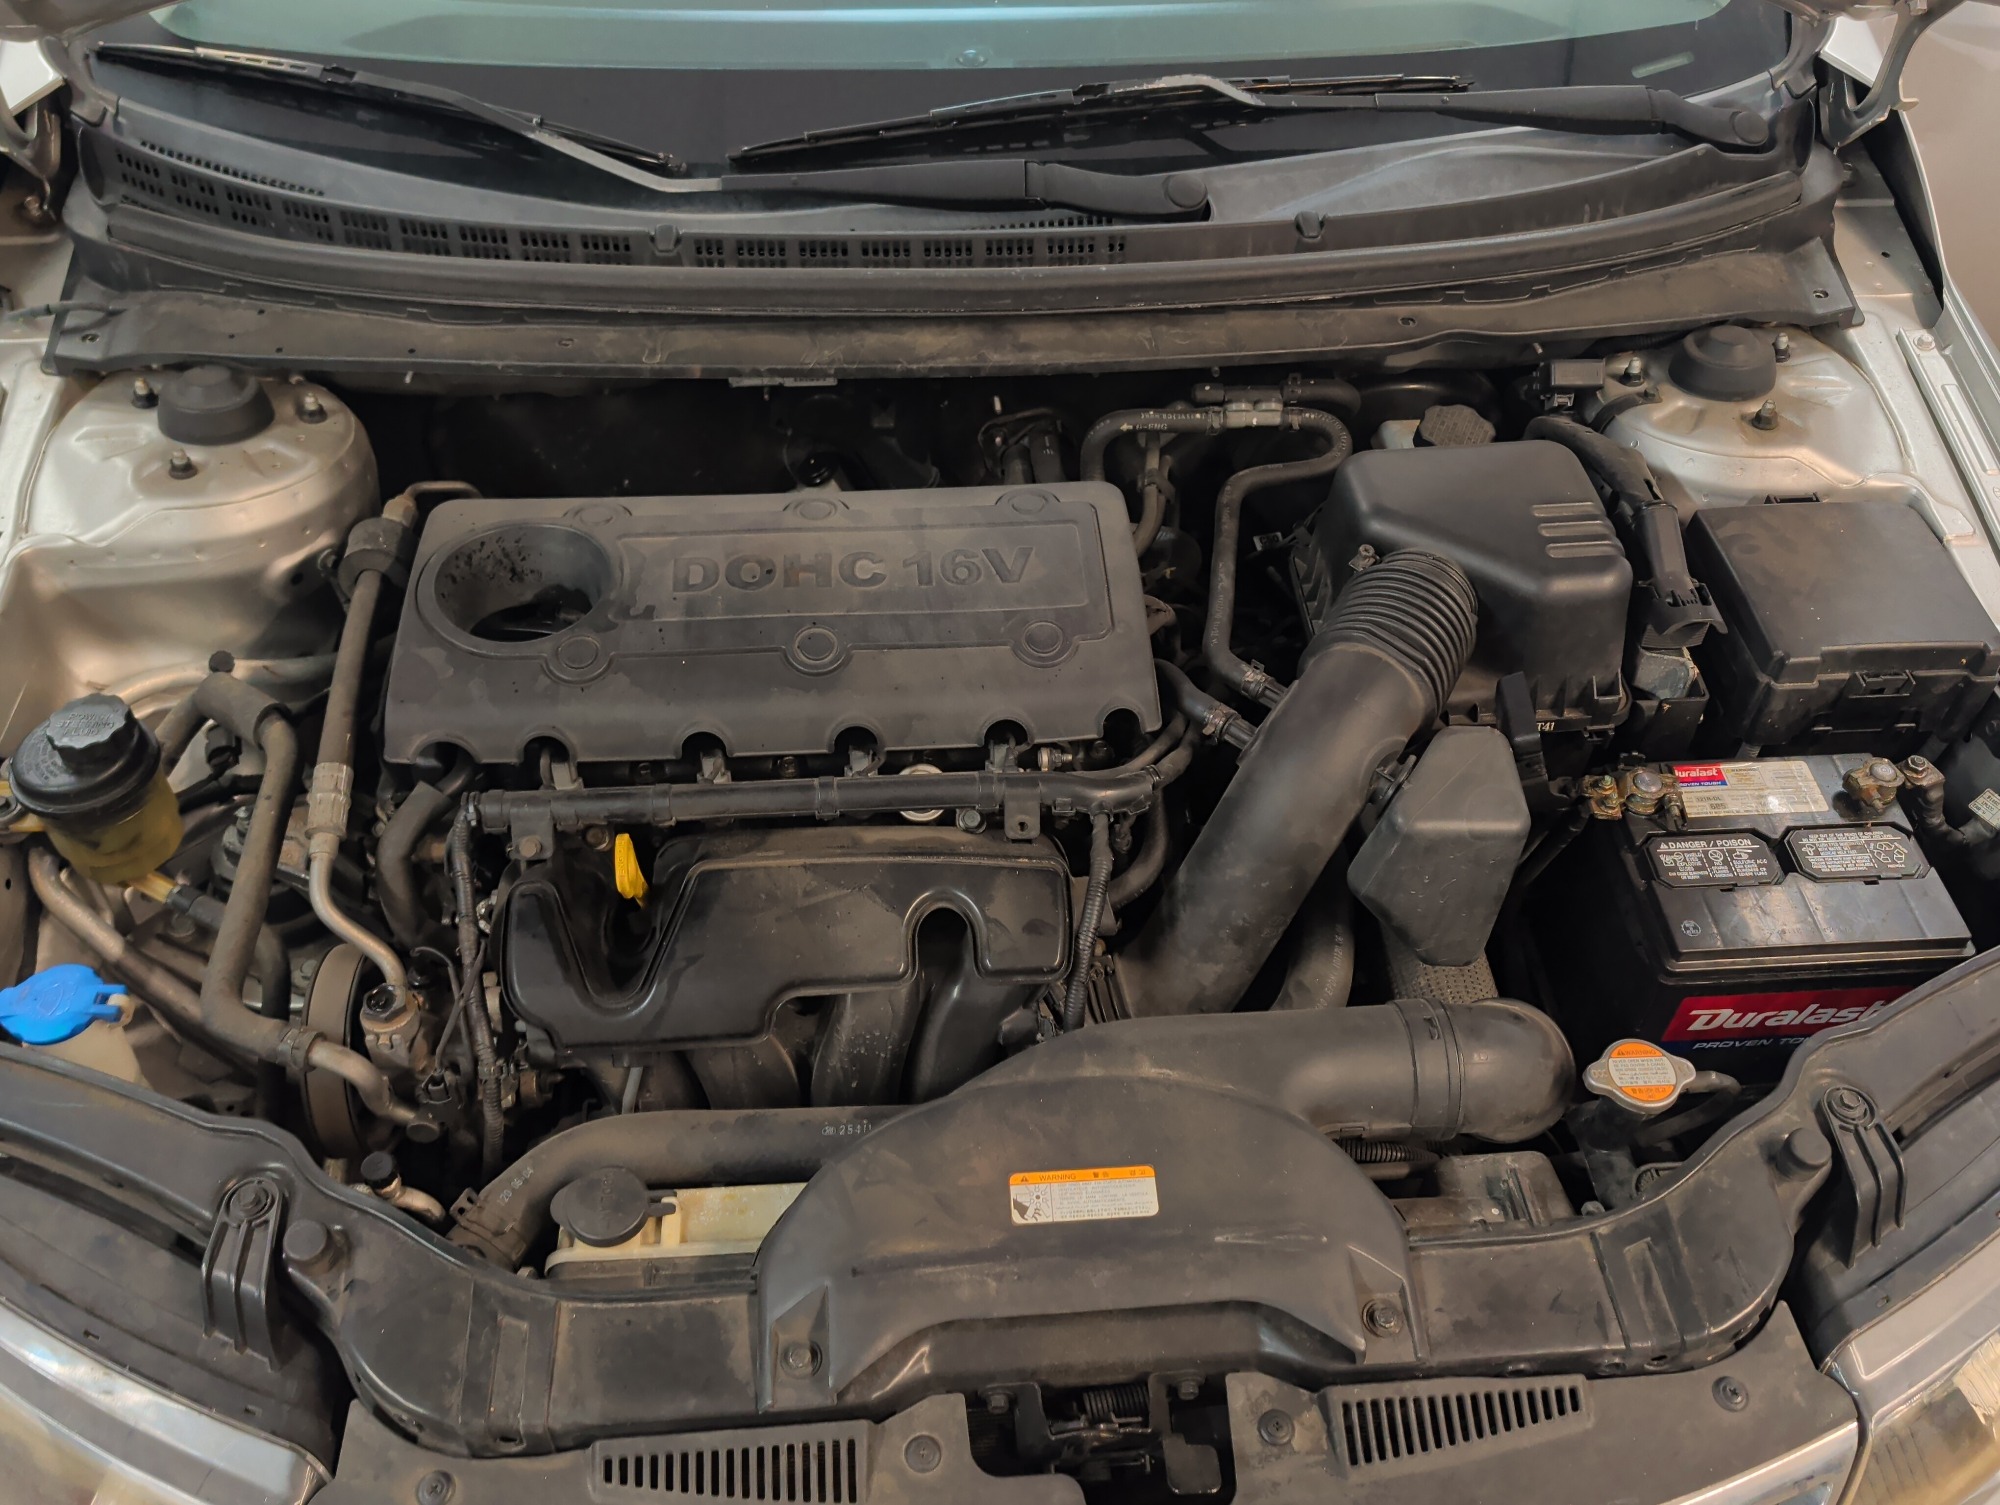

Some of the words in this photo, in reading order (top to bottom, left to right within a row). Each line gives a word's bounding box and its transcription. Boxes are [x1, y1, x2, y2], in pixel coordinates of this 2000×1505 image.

[672, 551, 887, 593] DOHC
[902, 546, 1035, 587] 16V
[1668, 840, 1708, 849] DANGER
[1716, 838, 1752, 847] POISON
[1686, 999, 1888, 1032] Duralast
[1692, 1038, 1774, 1050] PROVEN
[1038, 1174, 1077, 1182] WARNING
